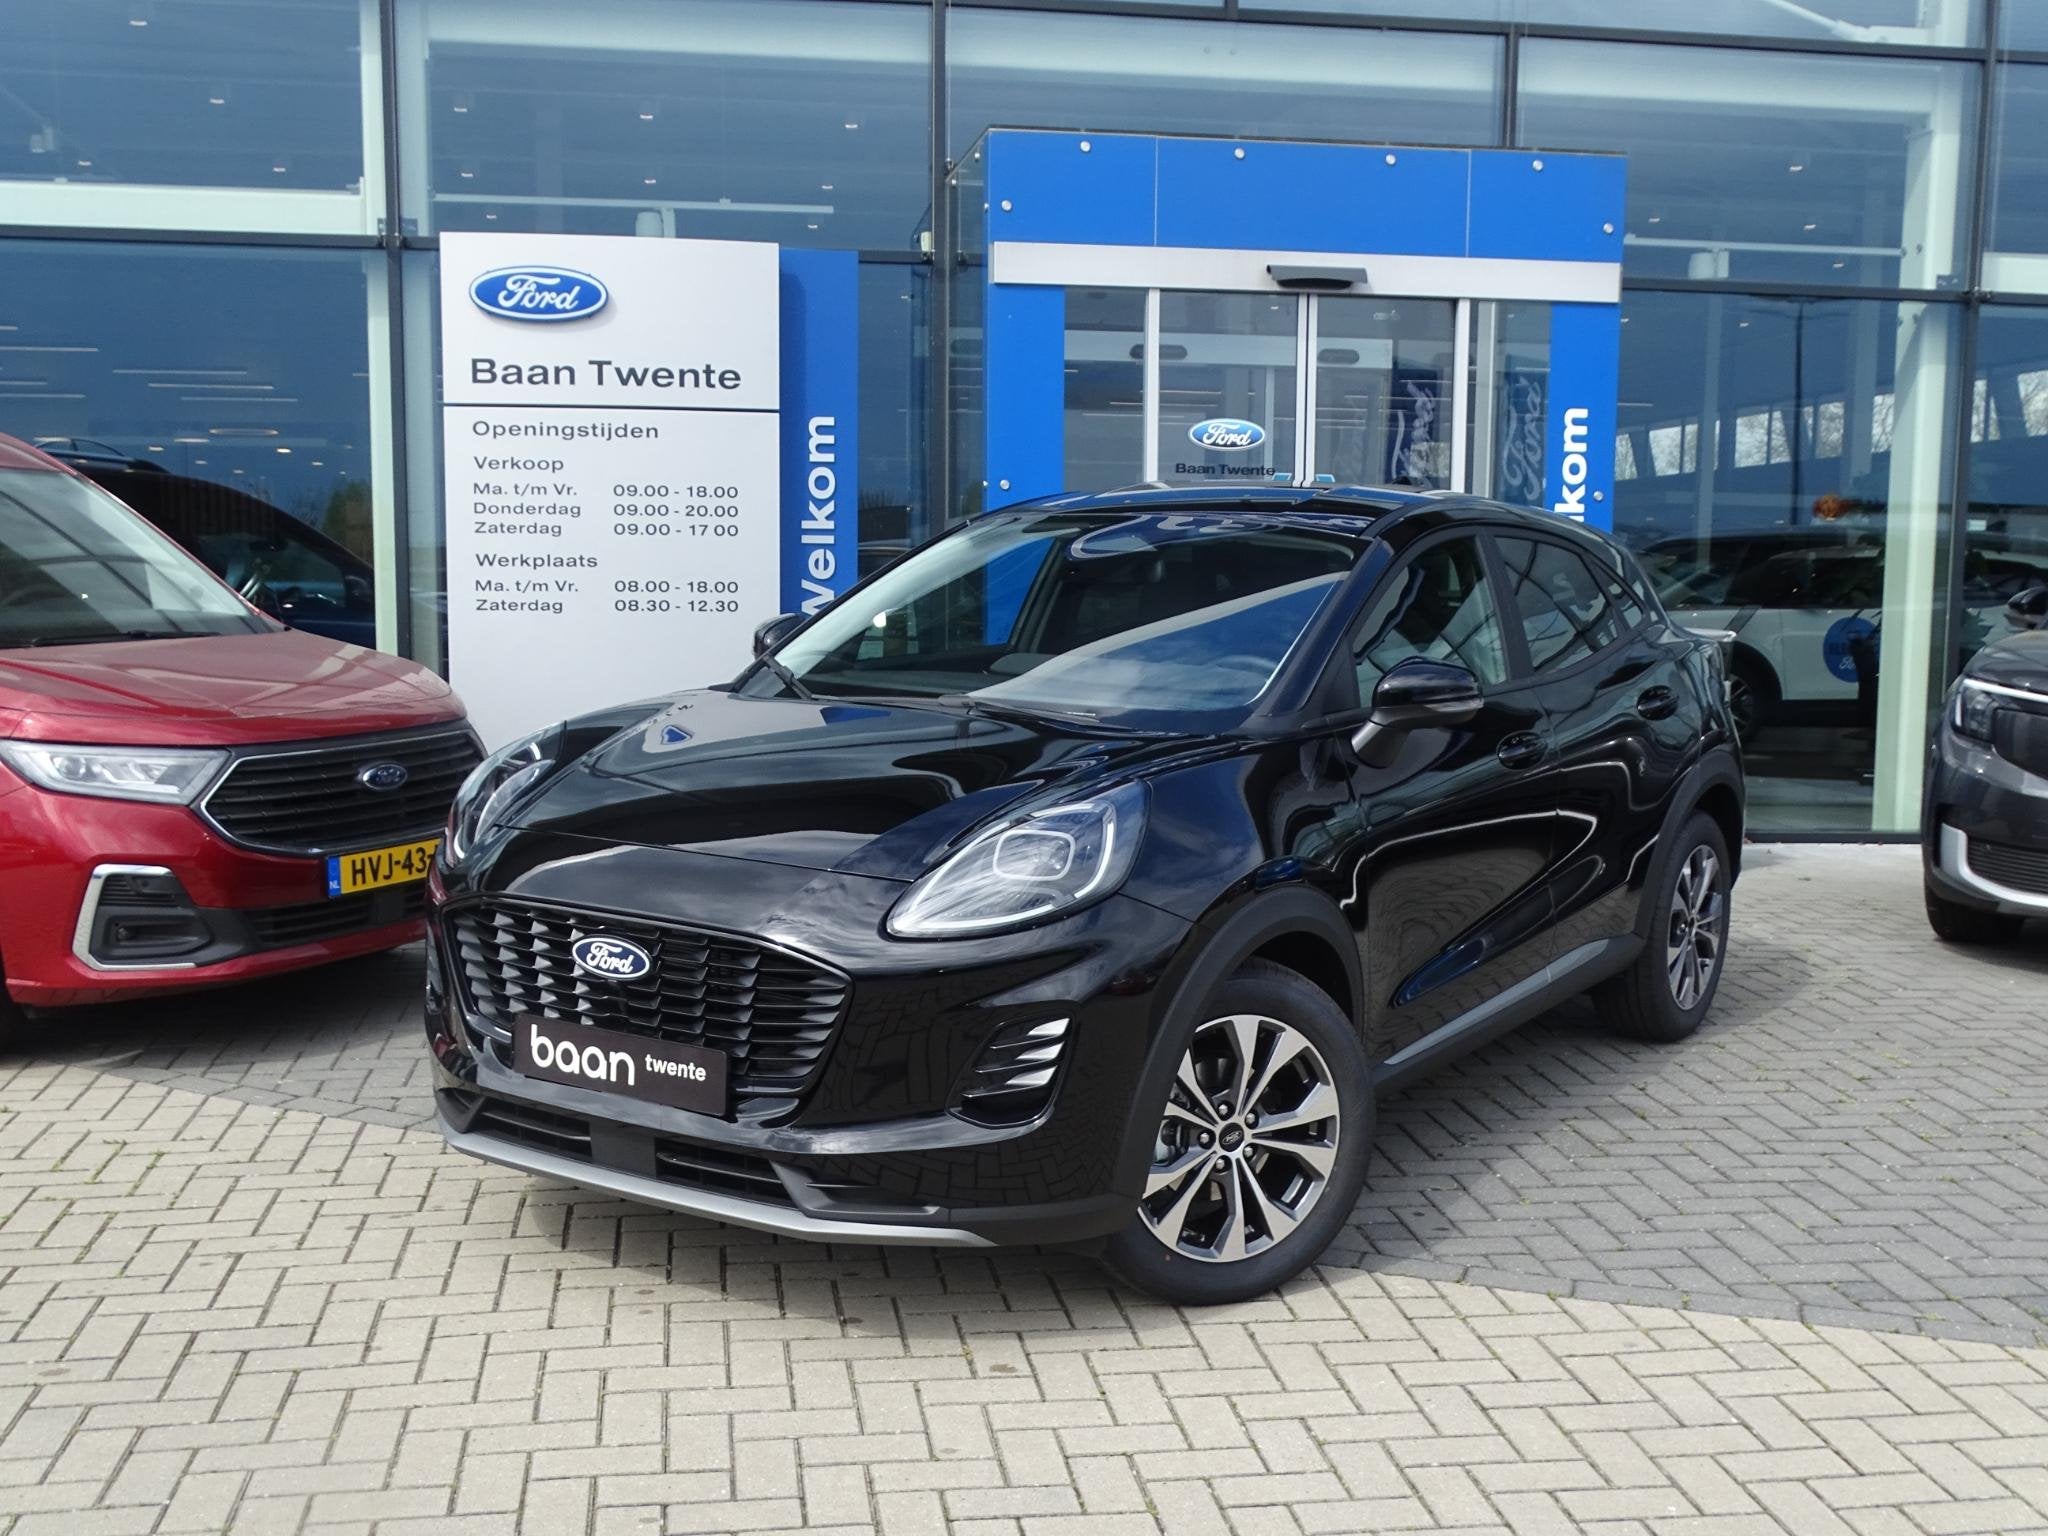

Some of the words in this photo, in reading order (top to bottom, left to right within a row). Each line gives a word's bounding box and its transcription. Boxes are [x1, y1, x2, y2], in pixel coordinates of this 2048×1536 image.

[498, 274, 581, 310] Ford
[471, 357, 577, 386] Baan
[588, 359, 742, 390] Twente
[472, 420, 660, 441] Openingstijden
[1202, 422, 1253, 447] Ford
[473, 455, 565, 474] Verkoop
[1175, 463, 1217, 475] Baan
[1219, 463, 1277, 476] Twente
[1554, 407, 1590, 523] kom
[473, 482, 508, 496] Ma.
[513, 483, 548, 496] t/m
[553, 483, 578, 496] Vr.
[612, 484, 670, 498] 09.00
[687, 485, 740, 499] 18.00
[473, 502, 582, 518] Donderdag
[613, 504, 670, 517] 09.00
[685, 504, 740, 518] 20.00
[474, 521, 563, 537] Zaterdag
[613, 523, 671, 536] 09.00
[475, 553, 599, 571] Werkplaats
[475, 579, 510, 593] Ma.
[515, 580, 550, 593] t/m
[555, 580, 579, 593] Vr.
[614, 580, 671, 593] 08.00
[687, 580, 740, 594] 18.00
[475, 599, 564, 614] Zaterdag
[614, 600, 671, 612] 08.30
[688, 600, 740, 613] 12.30
[329, 881, 340, 889] NL
[586, 941, 634, 974] Ford
[530, 1023, 636, 1087] baan
[645, 1053, 707, 1082] twente
